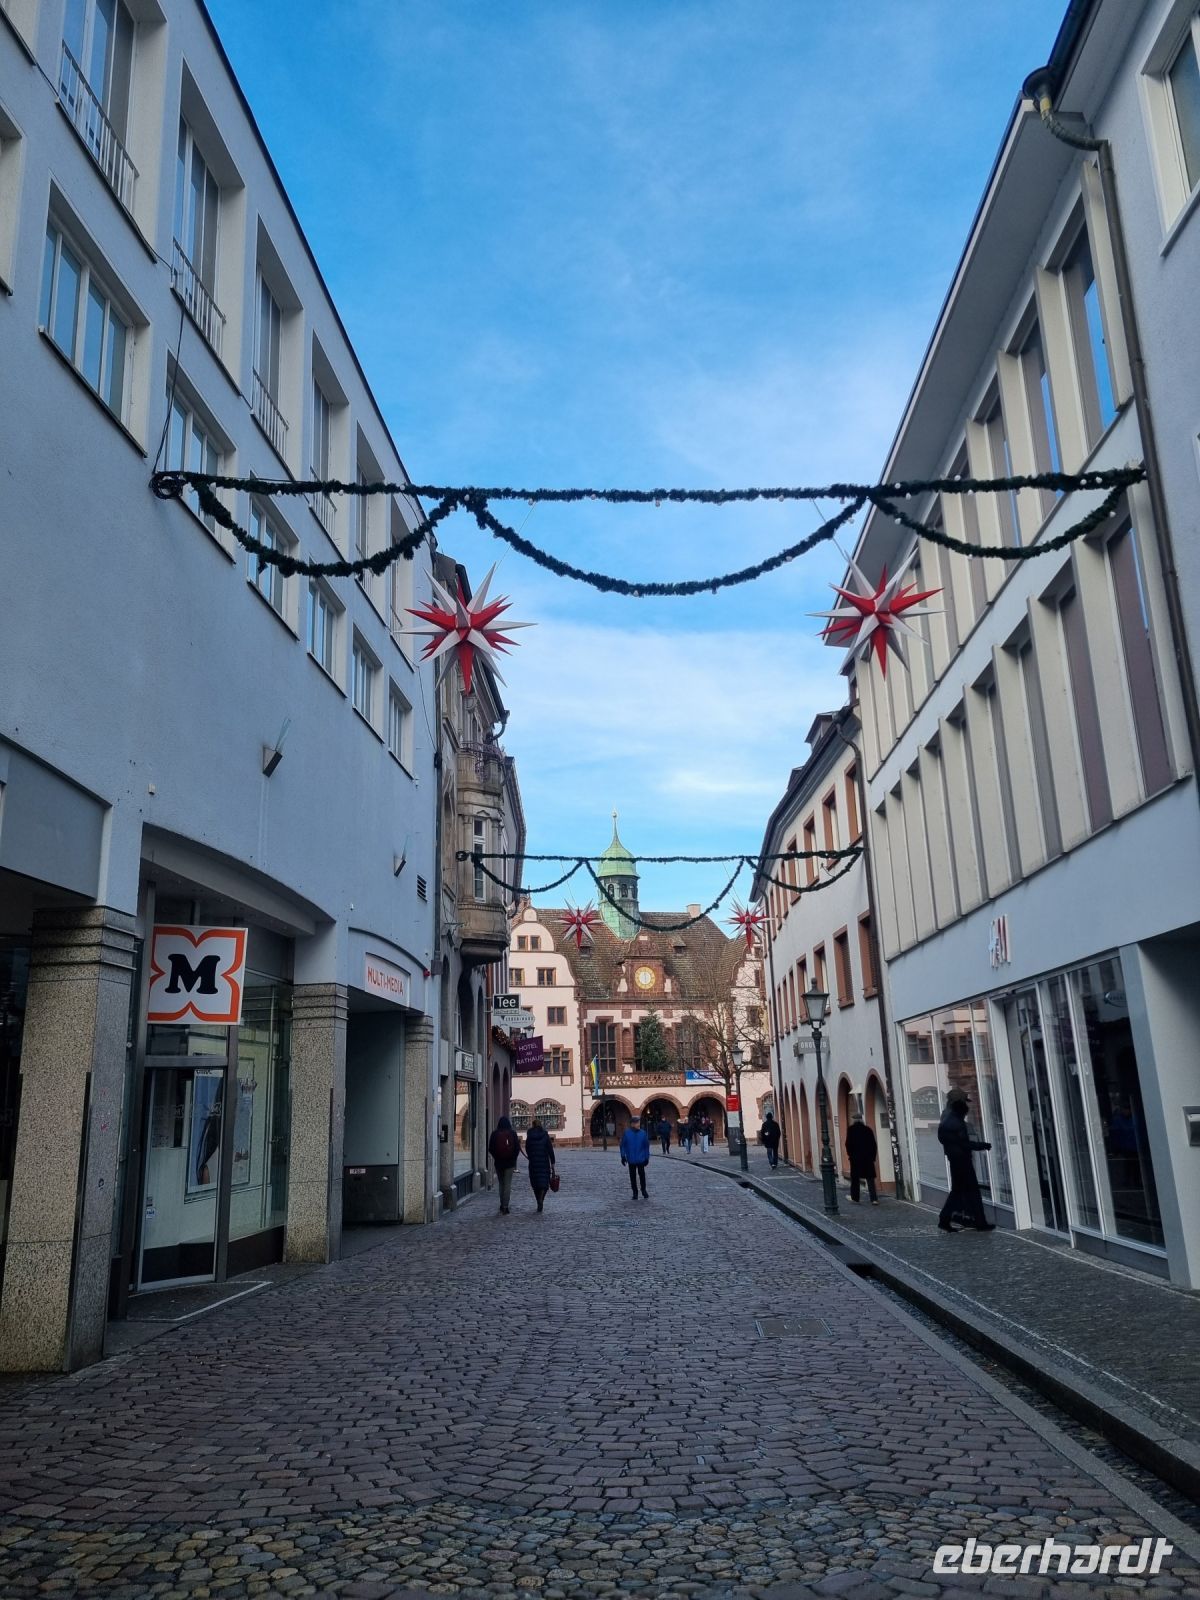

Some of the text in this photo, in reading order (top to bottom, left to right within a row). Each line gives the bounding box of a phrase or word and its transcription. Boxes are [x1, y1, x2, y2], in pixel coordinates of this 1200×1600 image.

[164, 953, 221, 995] M
[496, 996, 516, 1008] Tee
[518, 1043, 538, 1052] HOTEL
[516, 1054, 544, 1065] RATHAUS
